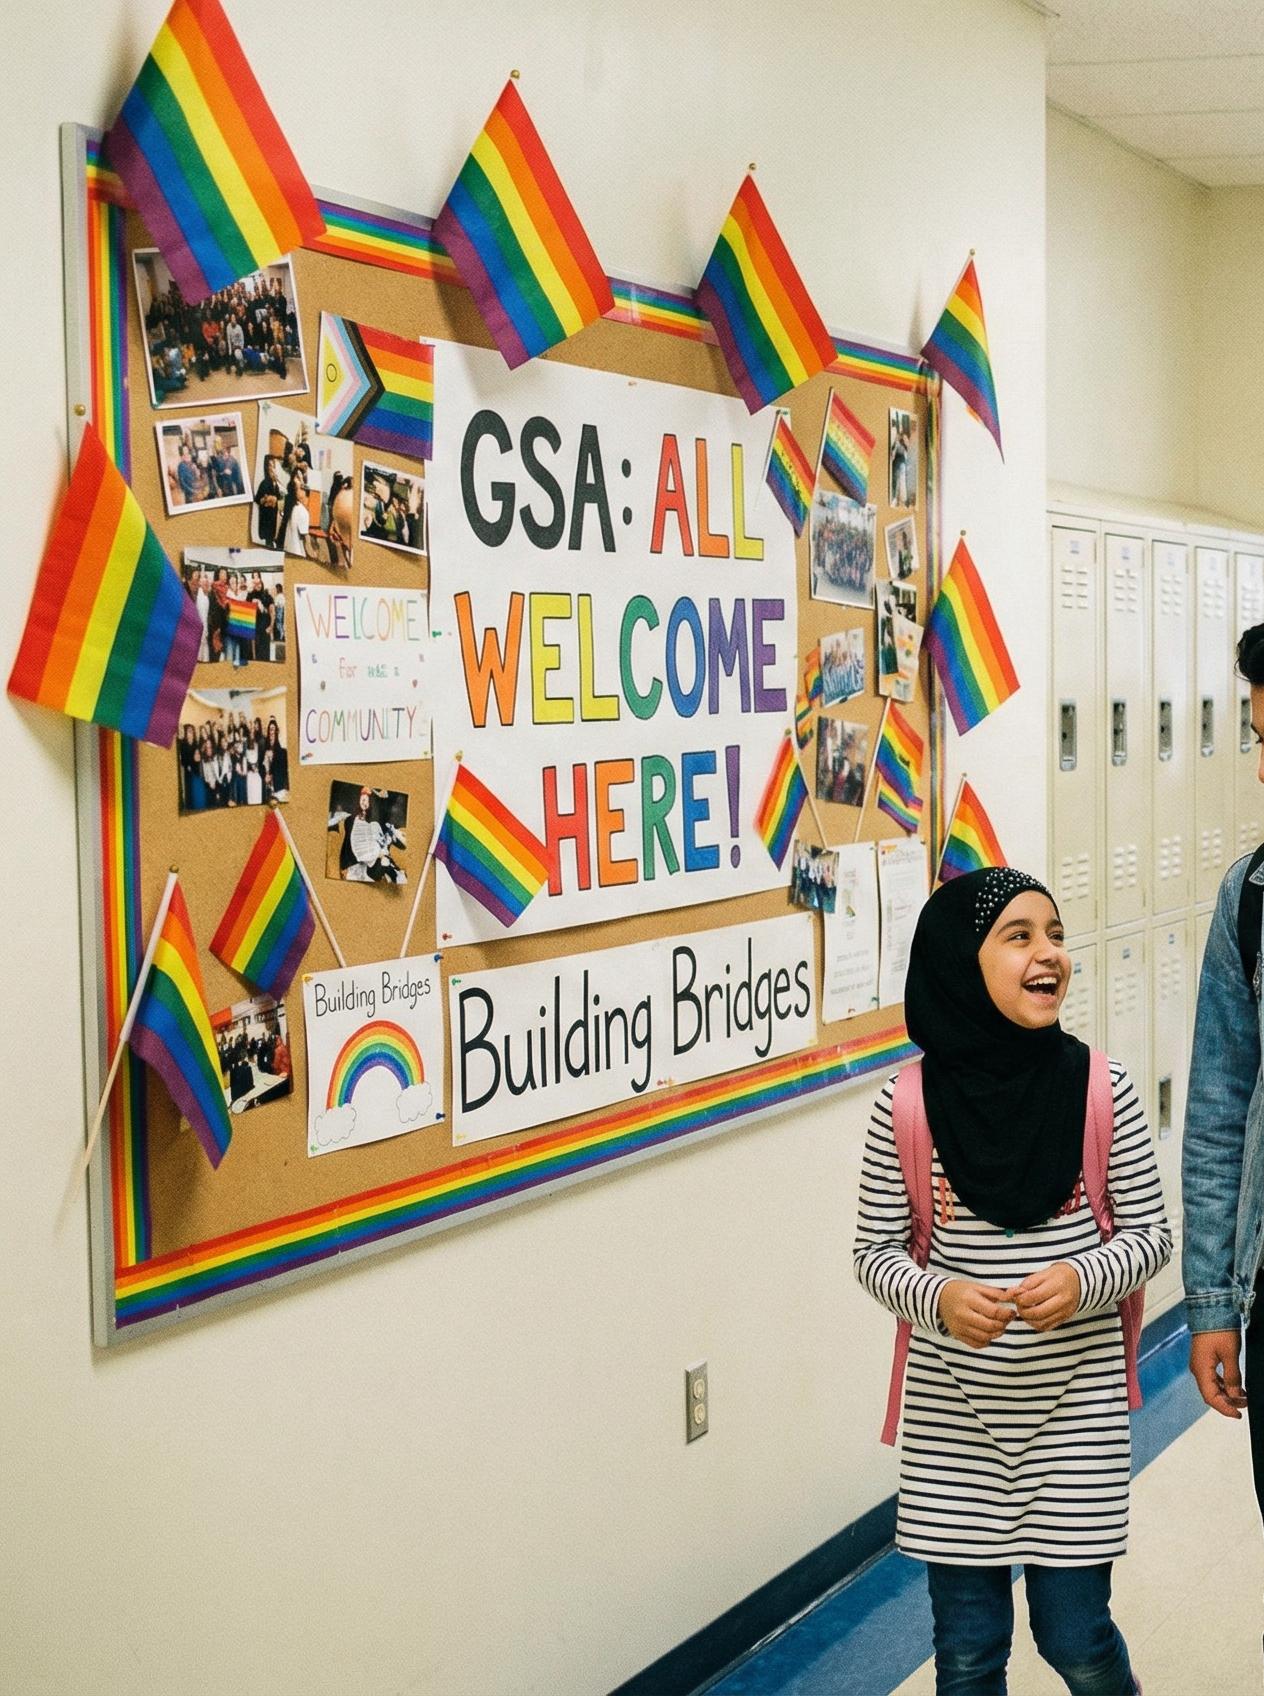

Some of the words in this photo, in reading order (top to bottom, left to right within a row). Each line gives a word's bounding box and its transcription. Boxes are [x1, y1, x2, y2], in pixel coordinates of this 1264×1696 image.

[460, 409, 633, 553] GSA:
[650, 433, 764, 561] ALL
[306, 593, 421, 642] WELCOME
[454, 591, 788, 728] WELCOME
[305, 706, 418, 744] COMMUNITY
[542, 744, 742, 897] HERE!
[314, 980, 376, 1018] Building
[381, 970, 431, 1010] Bridges
[459, 969, 652, 1114] Building
[671, 937, 812, 1058] Bridges
